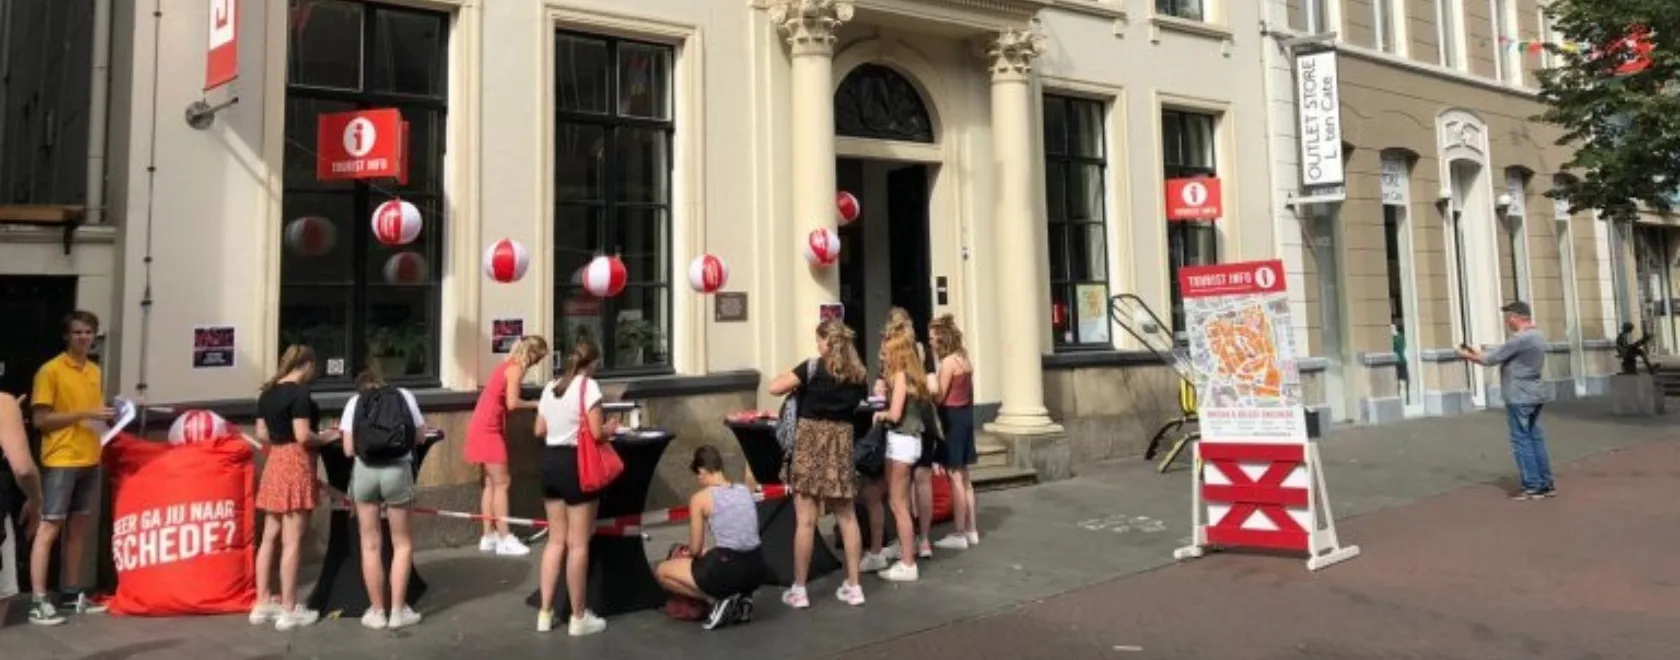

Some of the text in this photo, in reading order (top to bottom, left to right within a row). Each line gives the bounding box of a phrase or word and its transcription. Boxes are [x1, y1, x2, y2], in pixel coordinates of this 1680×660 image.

[1321, 76, 1334, 111] Cate
[1302, 57, 1322, 180] OUTLET STORE
[1324, 116, 1336, 142] ten
[332, 158, 388, 172] TOURIST INFO
[1187, 273, 1227, 288] TOURIST
[1229, 271, 1252, 284] INFO
[141, 507, 161, 529] GA
[190, 499, 235, 521] NAAR
